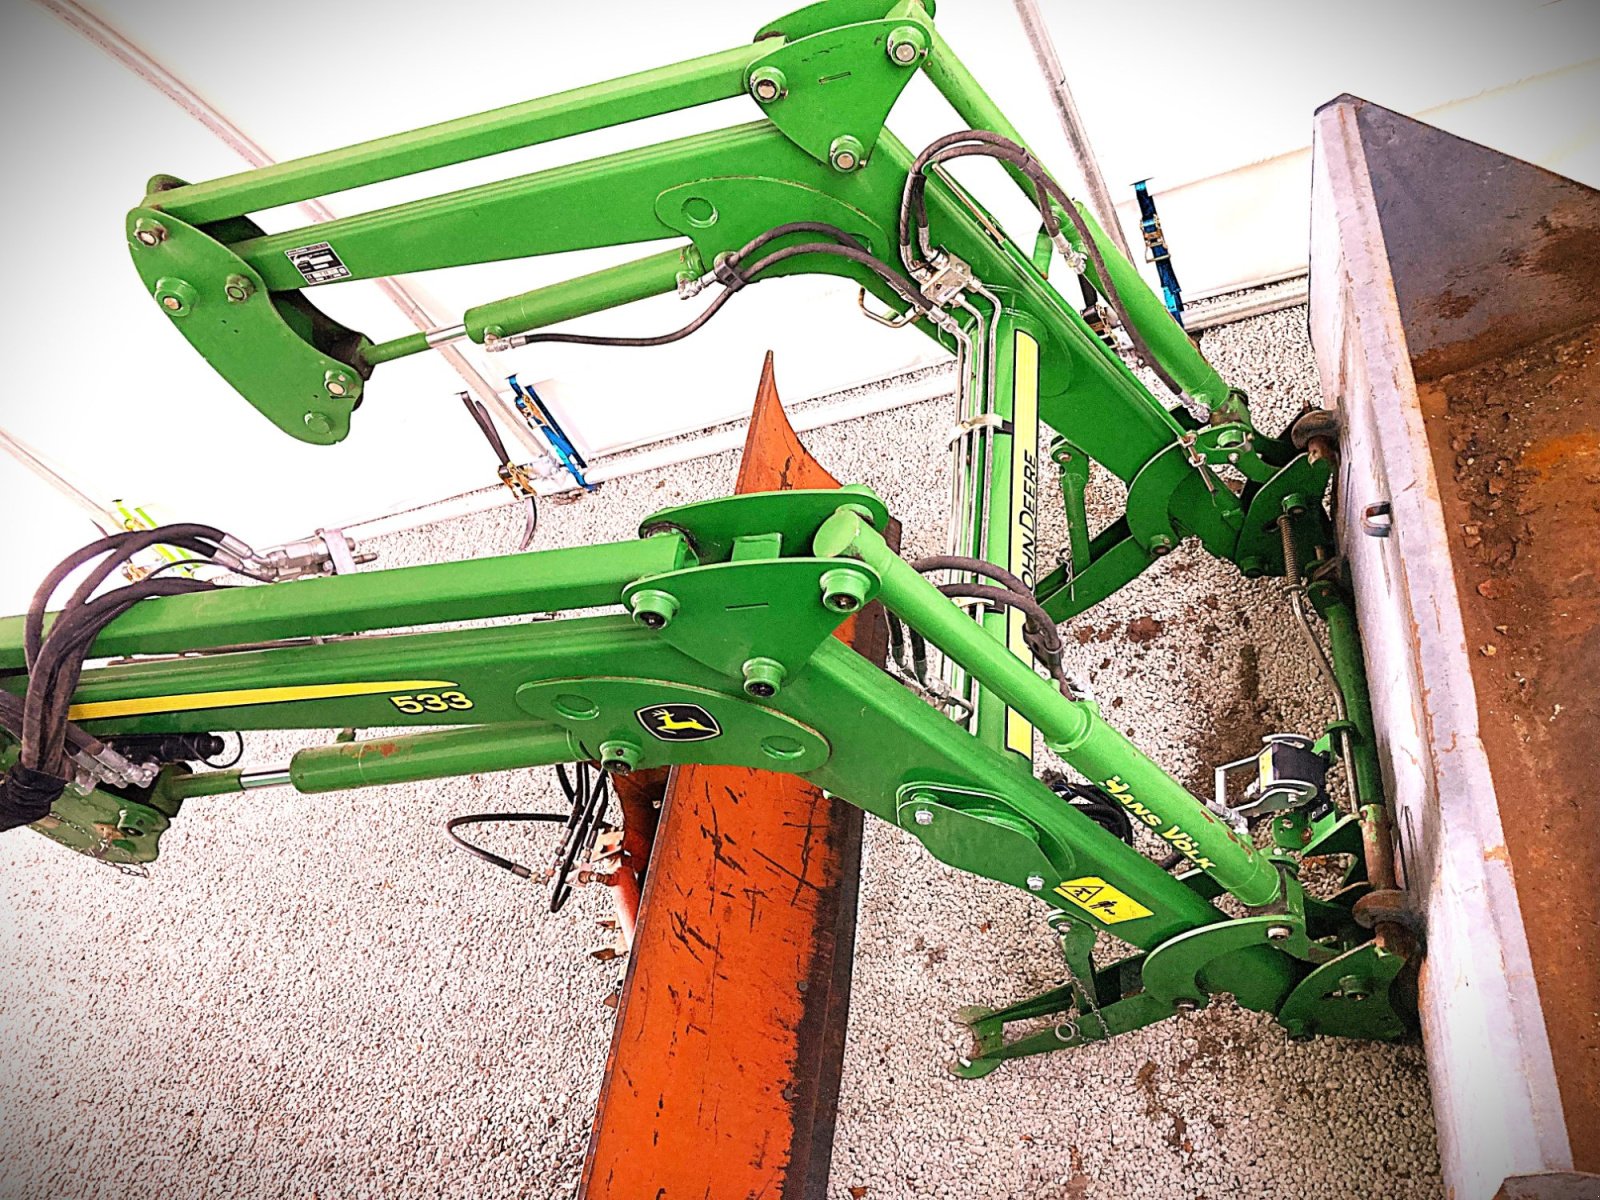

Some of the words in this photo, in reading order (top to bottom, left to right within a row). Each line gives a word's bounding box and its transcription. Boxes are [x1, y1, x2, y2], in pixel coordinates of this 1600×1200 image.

[1019, 449, 1037, 534] DEERE
[1021, 533, 1036, 591] OHN
[389, 691, 474, 714] 533
